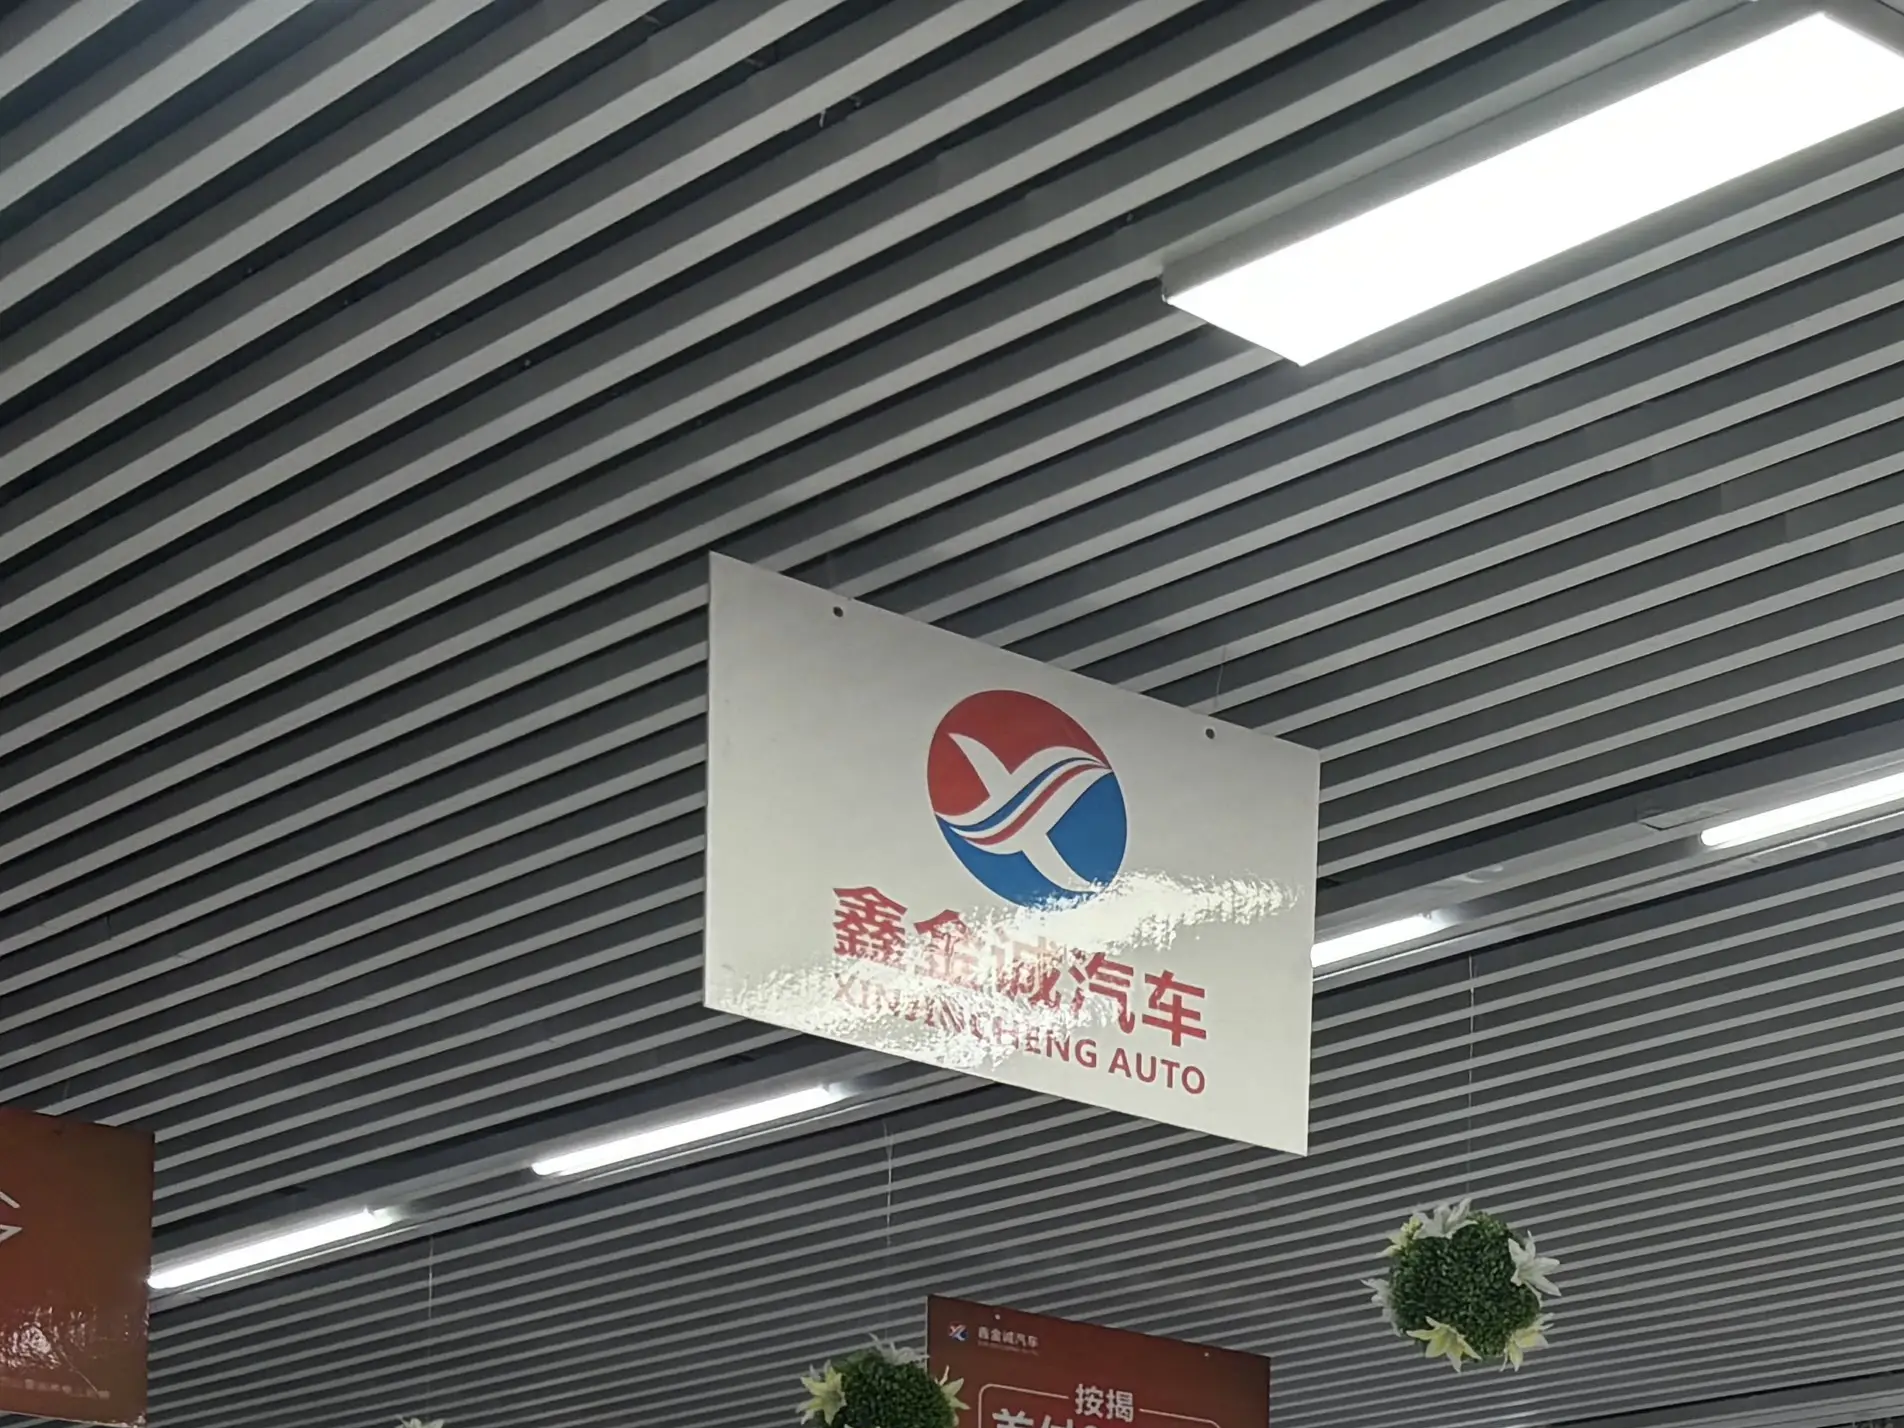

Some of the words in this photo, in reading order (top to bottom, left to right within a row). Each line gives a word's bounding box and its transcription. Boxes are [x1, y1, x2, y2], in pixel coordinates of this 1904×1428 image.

[834, 886, 1207, 1047] 鑫金诚汽车
[1109, 1047, 1206, 1095] AUTO
[1074, 1383, 1135, 1423] 按揭
